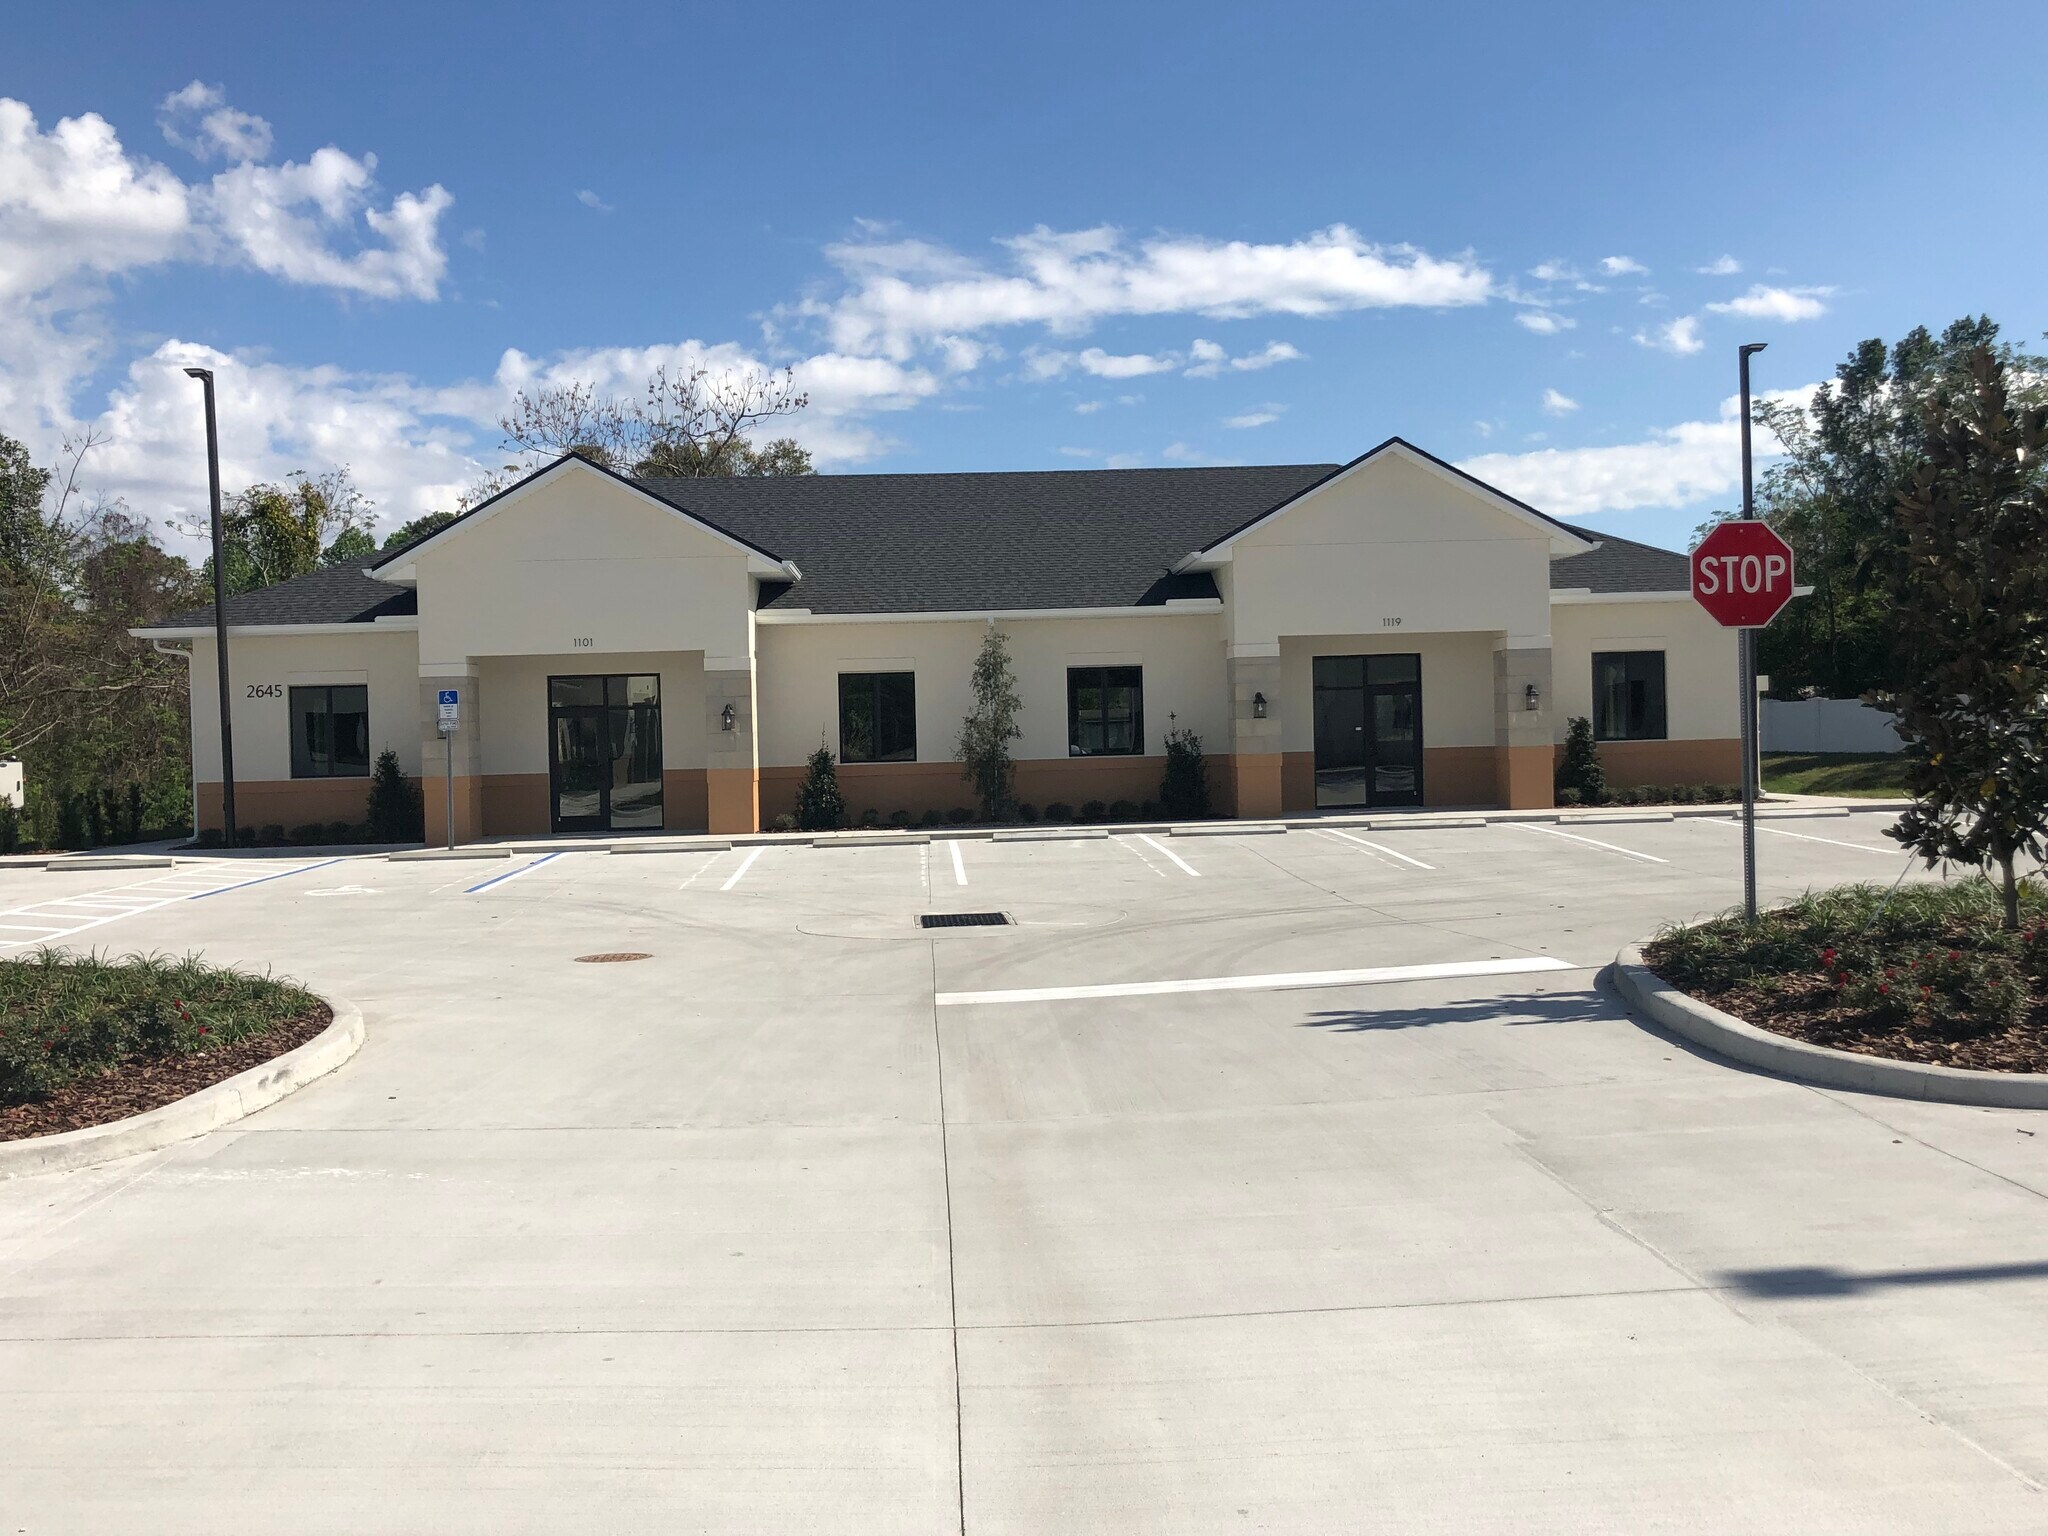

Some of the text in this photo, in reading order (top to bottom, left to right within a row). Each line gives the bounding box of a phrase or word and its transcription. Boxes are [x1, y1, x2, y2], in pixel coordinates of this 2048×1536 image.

[1698, 554, 1786, 595] STOP
[1382, 617, 1402, 627] 1119
[573, 637, 593, 647] 1101
[246, 684, 283, 698] 2645
